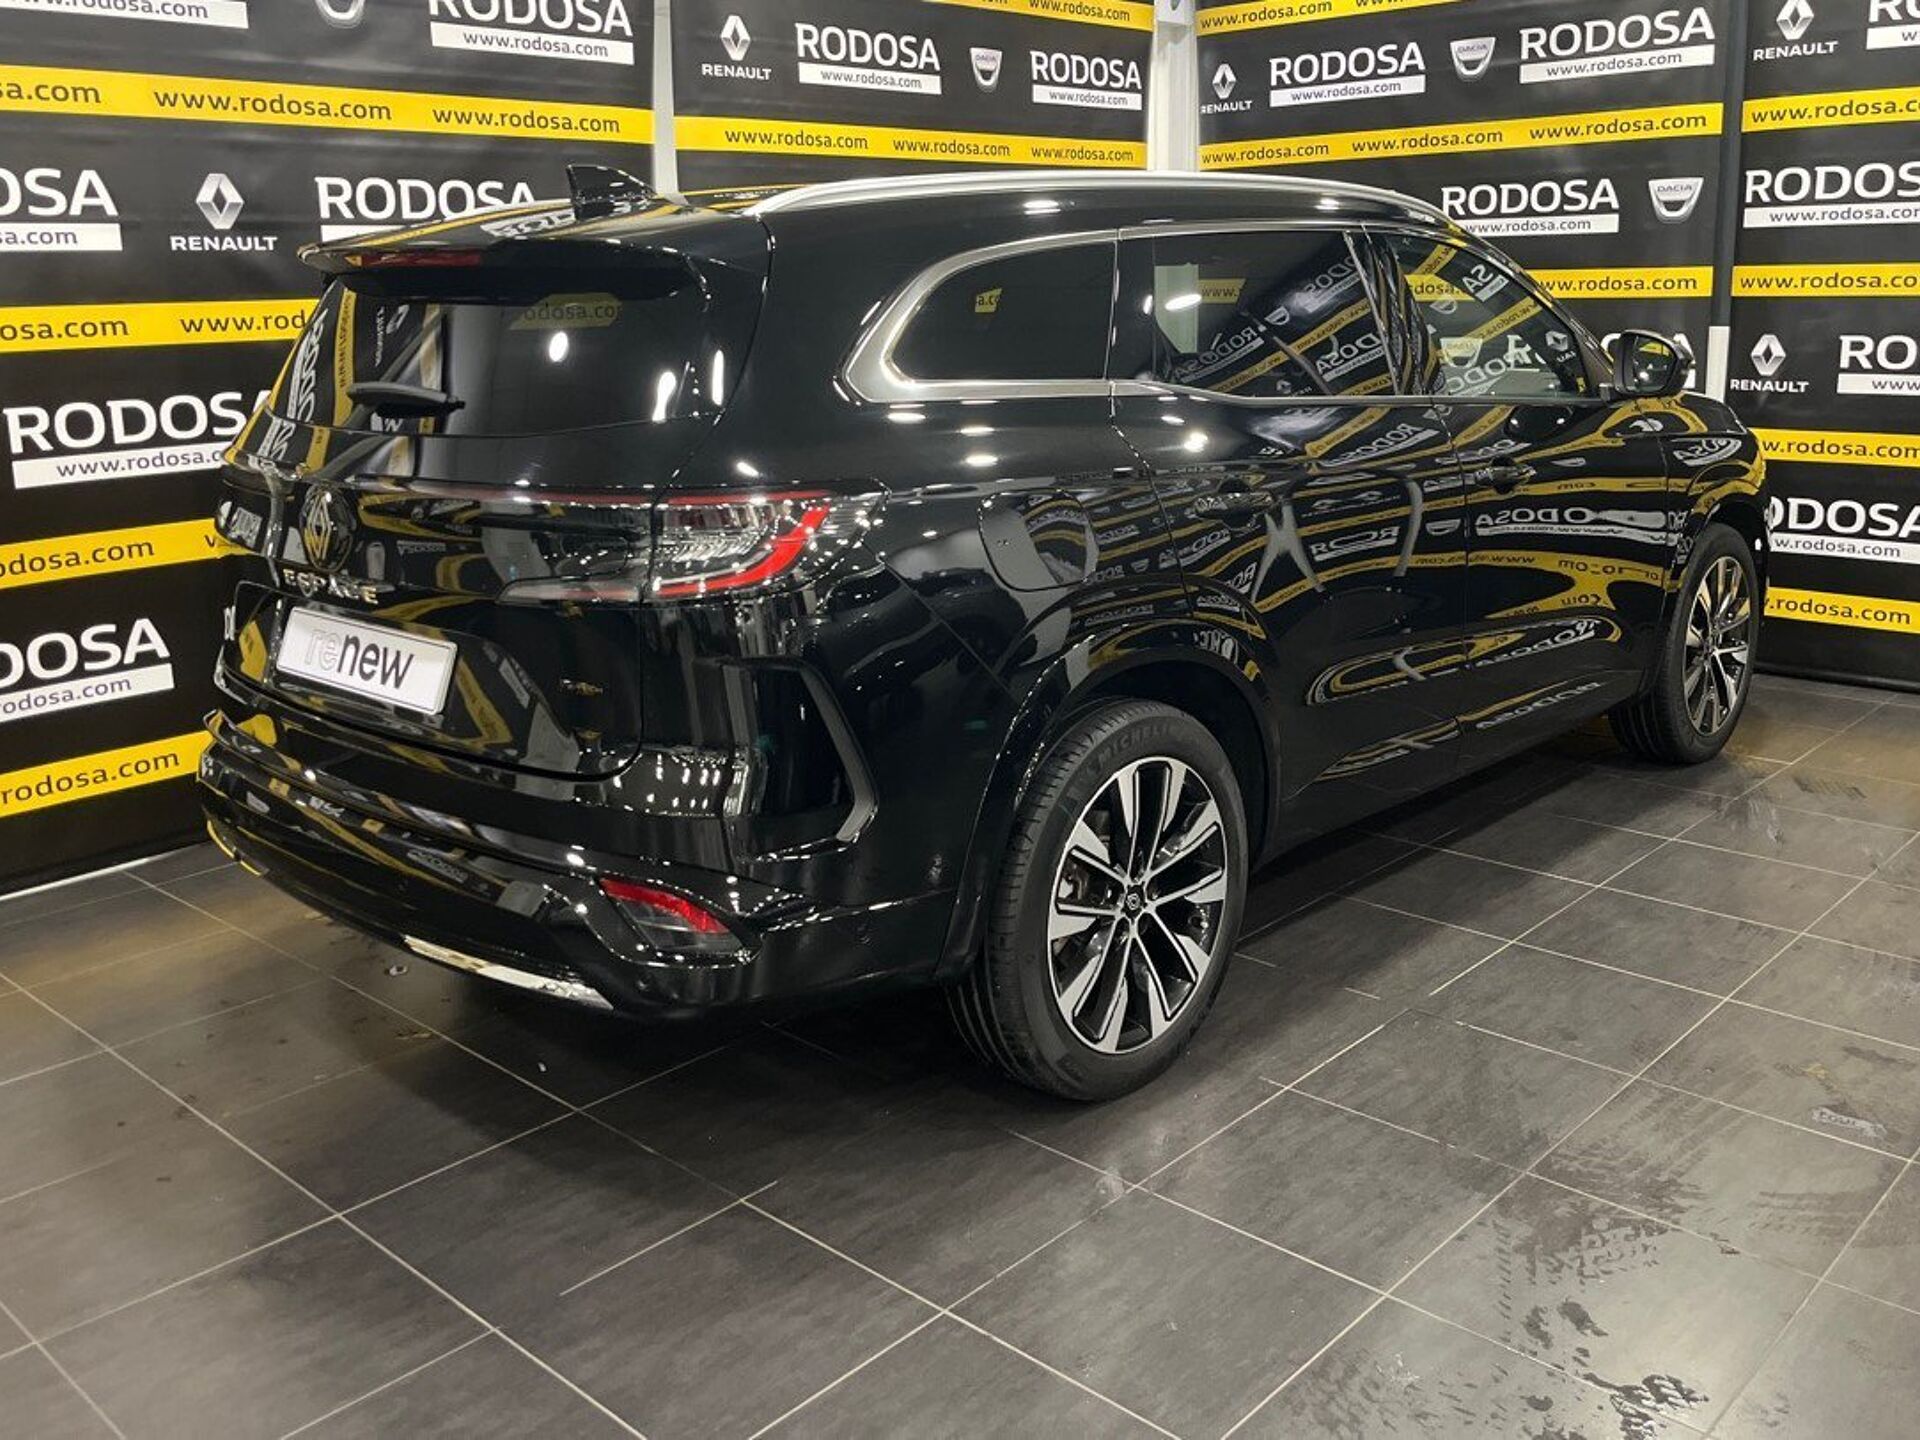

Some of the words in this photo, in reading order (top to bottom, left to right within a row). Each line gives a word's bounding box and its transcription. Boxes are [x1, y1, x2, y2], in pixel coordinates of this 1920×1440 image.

[12, 0, 208, 18] .rodosa.com
[1029, 0, 1130, 21] www.rodosa.com
[1201, 0, 1332, 29] www.rodosa.com
[463, 32, 609, 57] www.rodosa.com
[1520, 7, 1715, 60] RODOSA
[795, 22, 940, 71] RODOSA
[1753, 41, 1838, 61] RENAULT
[701, 63, 772, 80] RENAULT
[1030, 50, 1142, 90] RODOSA
[1269, 42, 1425, 86] RODOSA
[1546, 52, 1682, 76] www.rodosa.com
[821, 69, 923, 89] www.rodosa.com
[0, 82, 101, 104] a.com
[1049, 89, 1128, 106] www.rodosa.com
[1291, 81, 1401, 101] www.rodosa.com
[154, 90, 391, 120] www.rodosa.com
[432, 108, 620, 133] www.rodosa.com
[1530, 114, 1707, 139] www.rodosa.com
[725, 129, 868, 149] www.rodosa.com
[893, 139, 1010, 157] www.rodosa.com
[1352, 130, 1503, 152] www.rodosa.com
[1031, 145, 1134, 162] www.rodosa.com
[1202, 142, 1329, 164] www.rodosa.com
[1746, 162, 1920, 203] RODOS
[1441, 178, 1620, 216] RODOSA
[1465, 218, 1591, 233] www.rodosa.com
[0, 230, 78, 245] a.com
[170, 236, 277, 251] RENAULT
[1740, 272, 1918, 289] www.rodosa.co
[0, 319, 129, 341] osa.com
[1839, 335, 1918, 370] RO
[1730, 378, 1809, 393] RENAULT
[56, 447, 221, 479] www.rodosa.c
[1765, 597, 1911, 625] .rodosa.com
[304, 628, 414, 689] renew
[0, 680, 132, 714] odosa.com
[1, 750, 180, 804] rodosa.com
